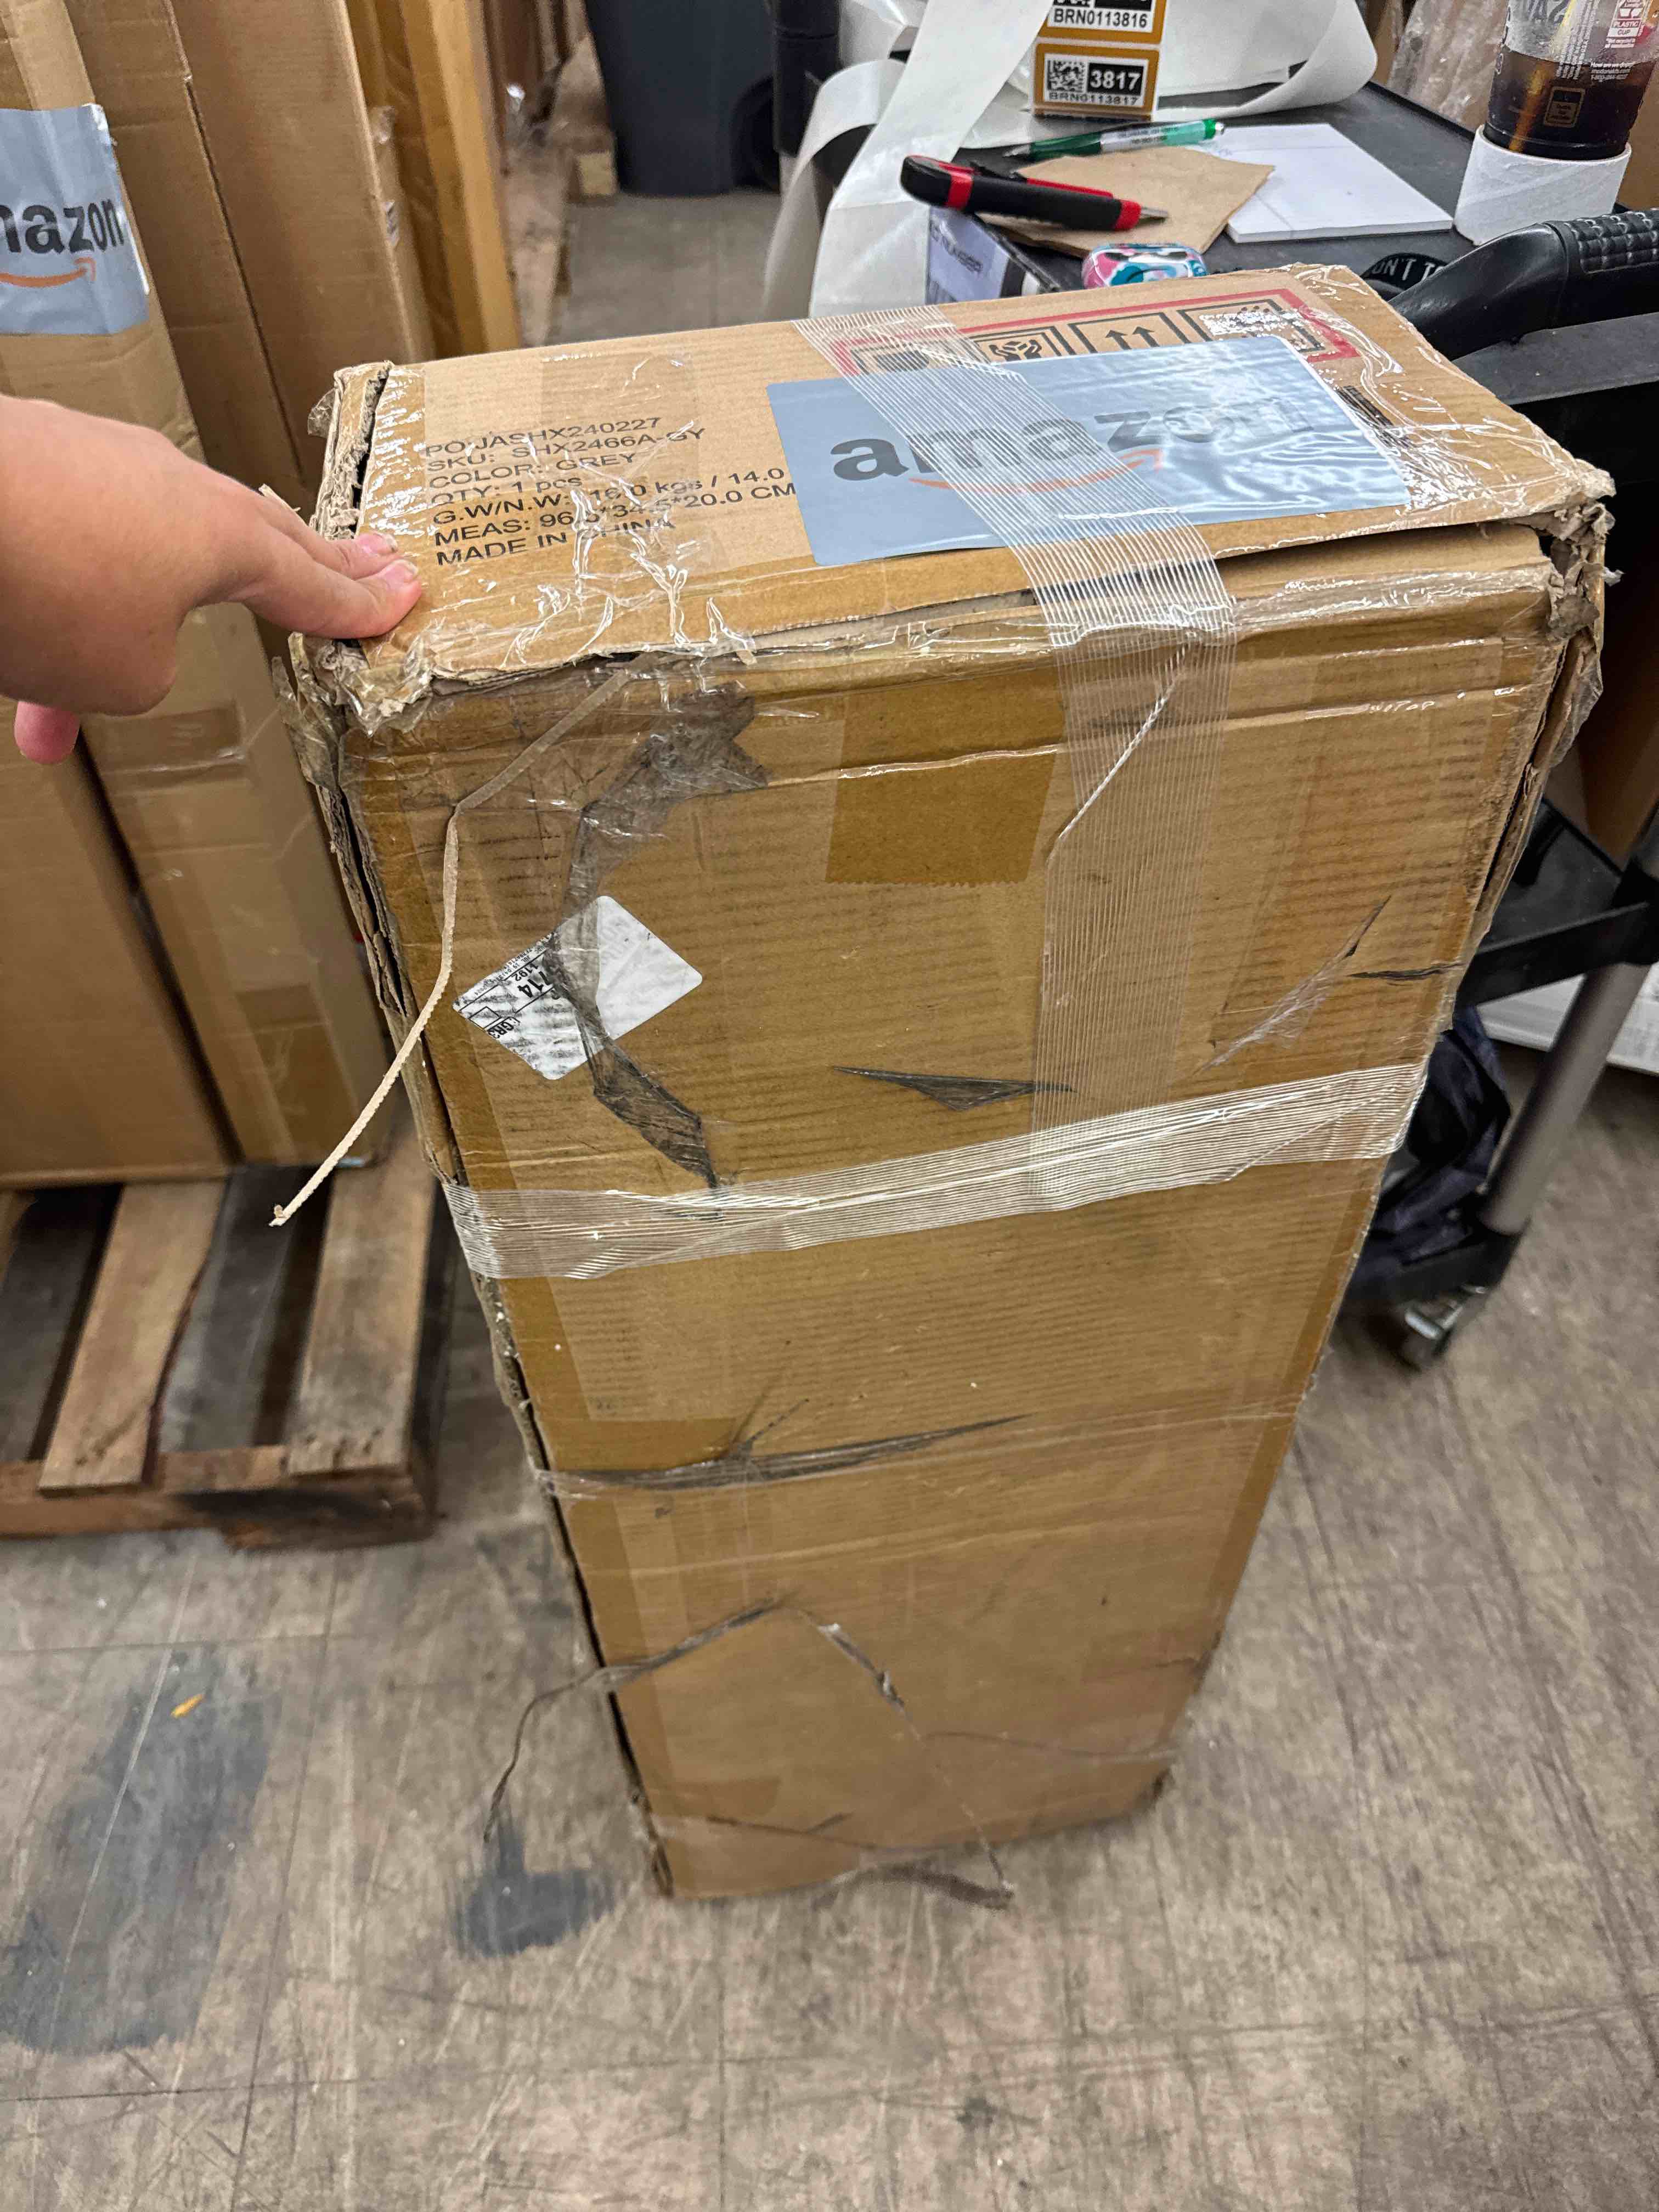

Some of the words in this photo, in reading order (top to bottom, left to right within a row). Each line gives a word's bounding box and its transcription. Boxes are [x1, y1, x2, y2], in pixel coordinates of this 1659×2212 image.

[1053, 8, 1148, 28] BRN0113816
[1090, 70, 1142, 91] 3817
[1048, 92, 1140, 105] BRN0113817
[1371, 258, 1417, 281] ON'T
[427, 453, 495, 471] SKU:
[429, 464, 543, 489] COLOR:
[556, 453, 636, 471] GREY
[511, 481, 523, 493] 1
[536, 477, 583, 493] pcs
[729, 468, 785, 484] 14.0
[435, 519, 531, 546] MEAS:
[751, 482, 796, 499] CM
[436, 538, 528, 566] MADE
[537, 532, 567, 548] IN
